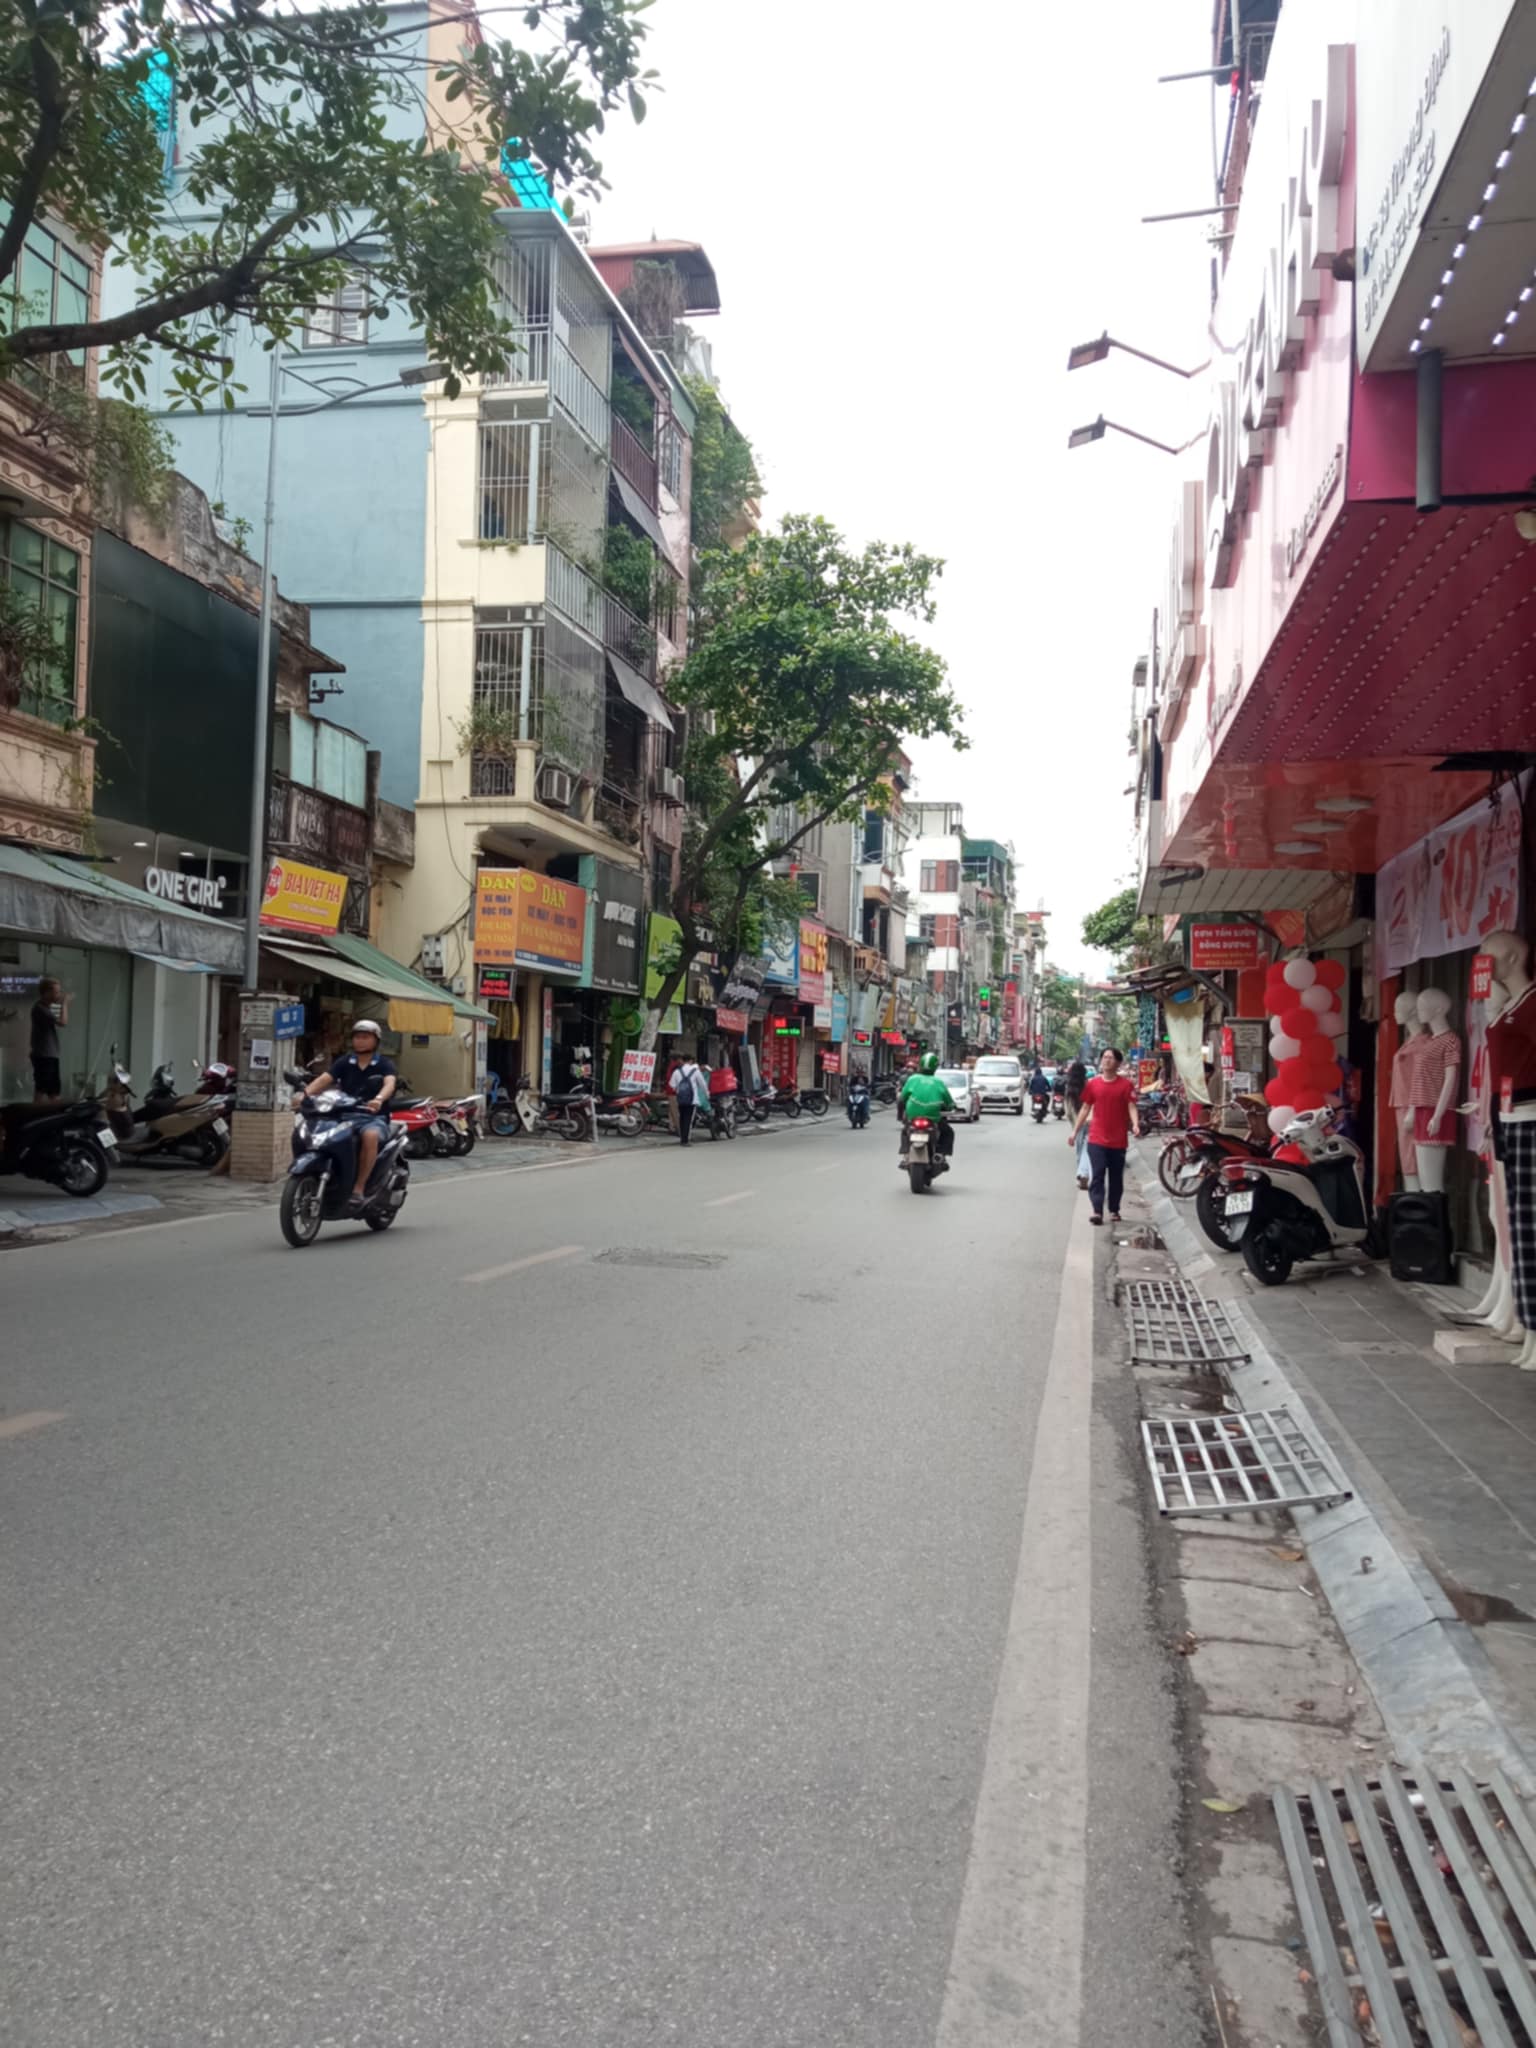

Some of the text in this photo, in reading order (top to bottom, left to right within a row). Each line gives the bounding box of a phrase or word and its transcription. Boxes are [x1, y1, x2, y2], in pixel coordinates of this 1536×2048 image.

[145, 865, 223, 908] ONE GIRL
[285, 872, 303, 894] BIA
